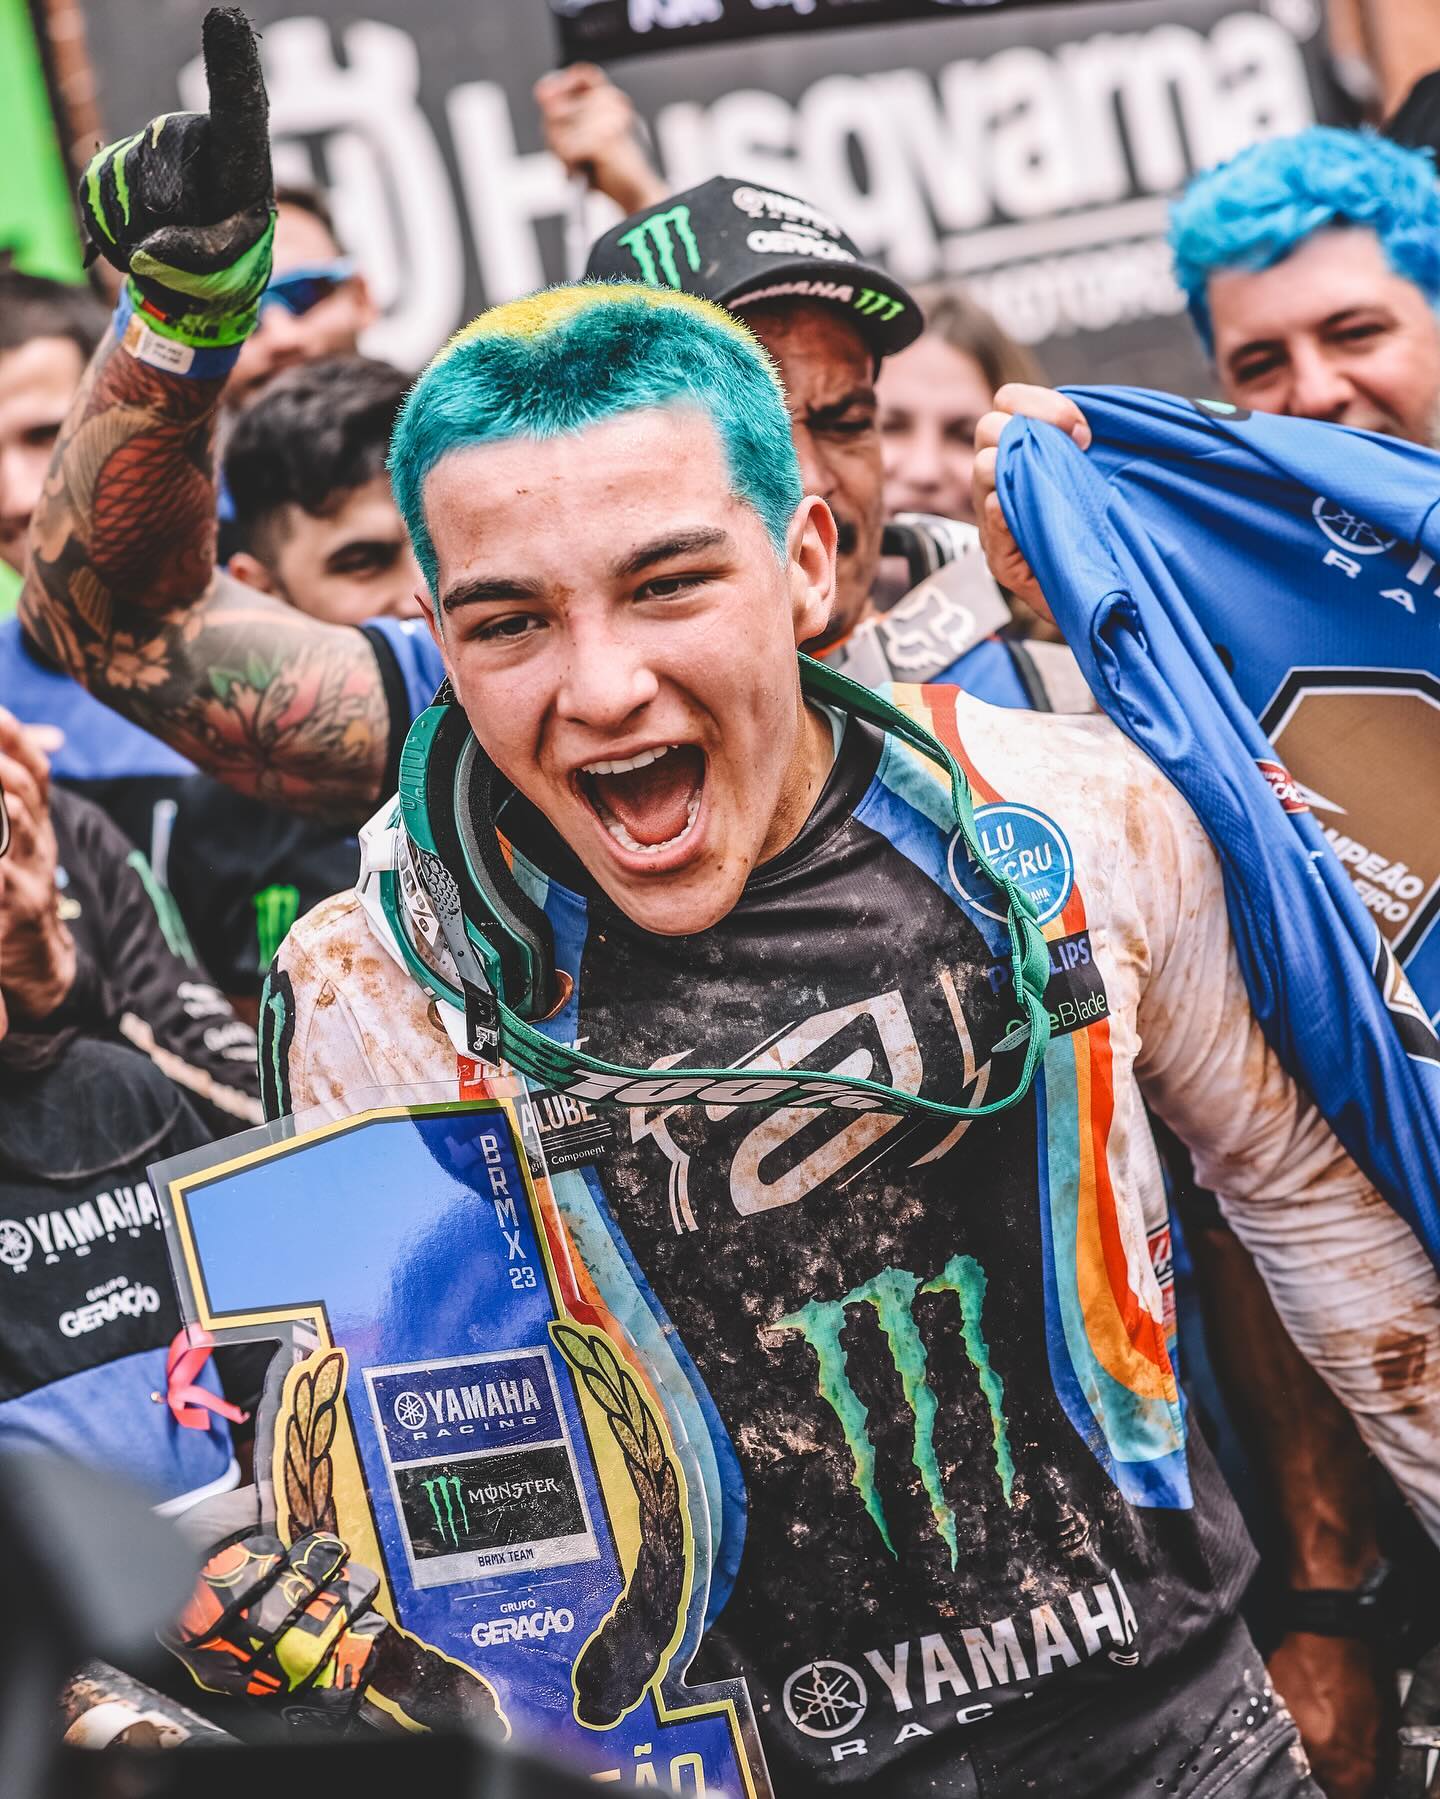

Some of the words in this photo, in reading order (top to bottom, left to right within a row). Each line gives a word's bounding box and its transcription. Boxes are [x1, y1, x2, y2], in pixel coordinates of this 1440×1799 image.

[1002, 843, 1053, 881] CRU
[987, 937, 1091, 994] PLIPS
[1006, 990, 1107, 1037] OeBlade
[564, 1069, 894, 1110] 100%
[519, 1094, 597, 1137] ALUBE
[551, 1145, 606, 1166] Component
[25, 1181, 162, 1254] YAMAHA
[480, 1135, 527, 1260] BRMX
[509, 1266, 537, 1289] 23
[425, 1378, 541, 1424] YAMAHA
[413, 1417, 538, 1441] RACING
[478, 1552, 506, 1567] BRMX
[508, 1548, 535, 1563] TEAM
[471, 1606, 575, 1648] GERAÇÃO
[500, 1599, 536, 1613] GRUPO
[830, 1696, 1010, 1762] RAC
